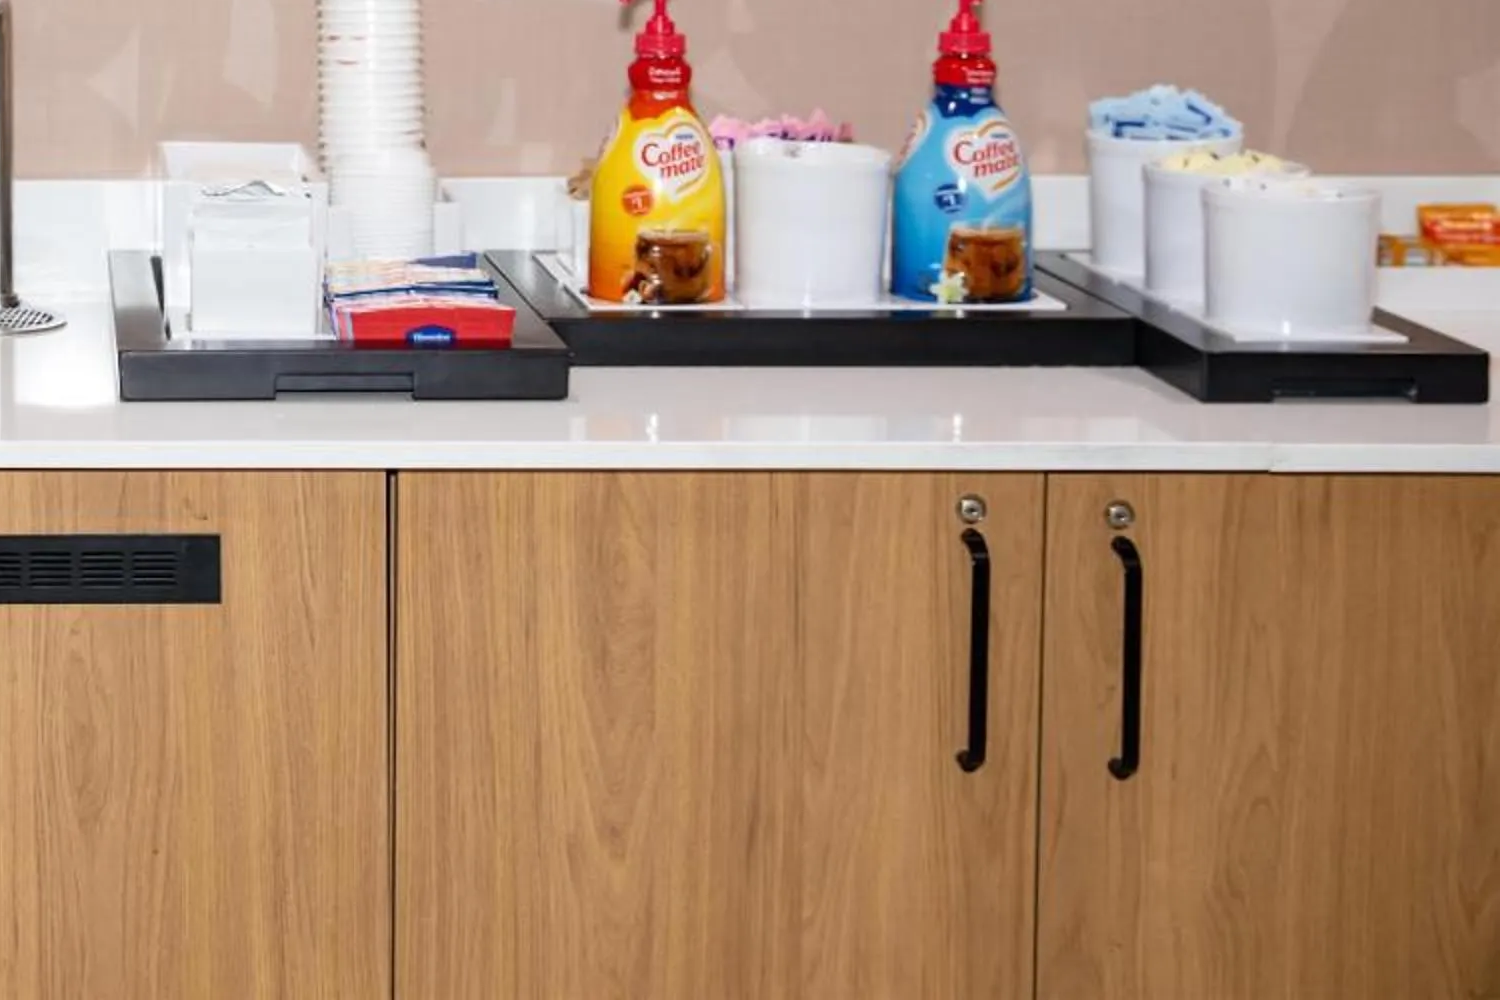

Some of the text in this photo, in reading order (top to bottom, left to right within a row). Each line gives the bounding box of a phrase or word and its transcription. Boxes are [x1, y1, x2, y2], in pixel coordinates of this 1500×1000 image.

[641, 142, 700, 167] Coffee
[953, 140, 1015, 165] Coffee
[660, 154, 704, 179] mate
